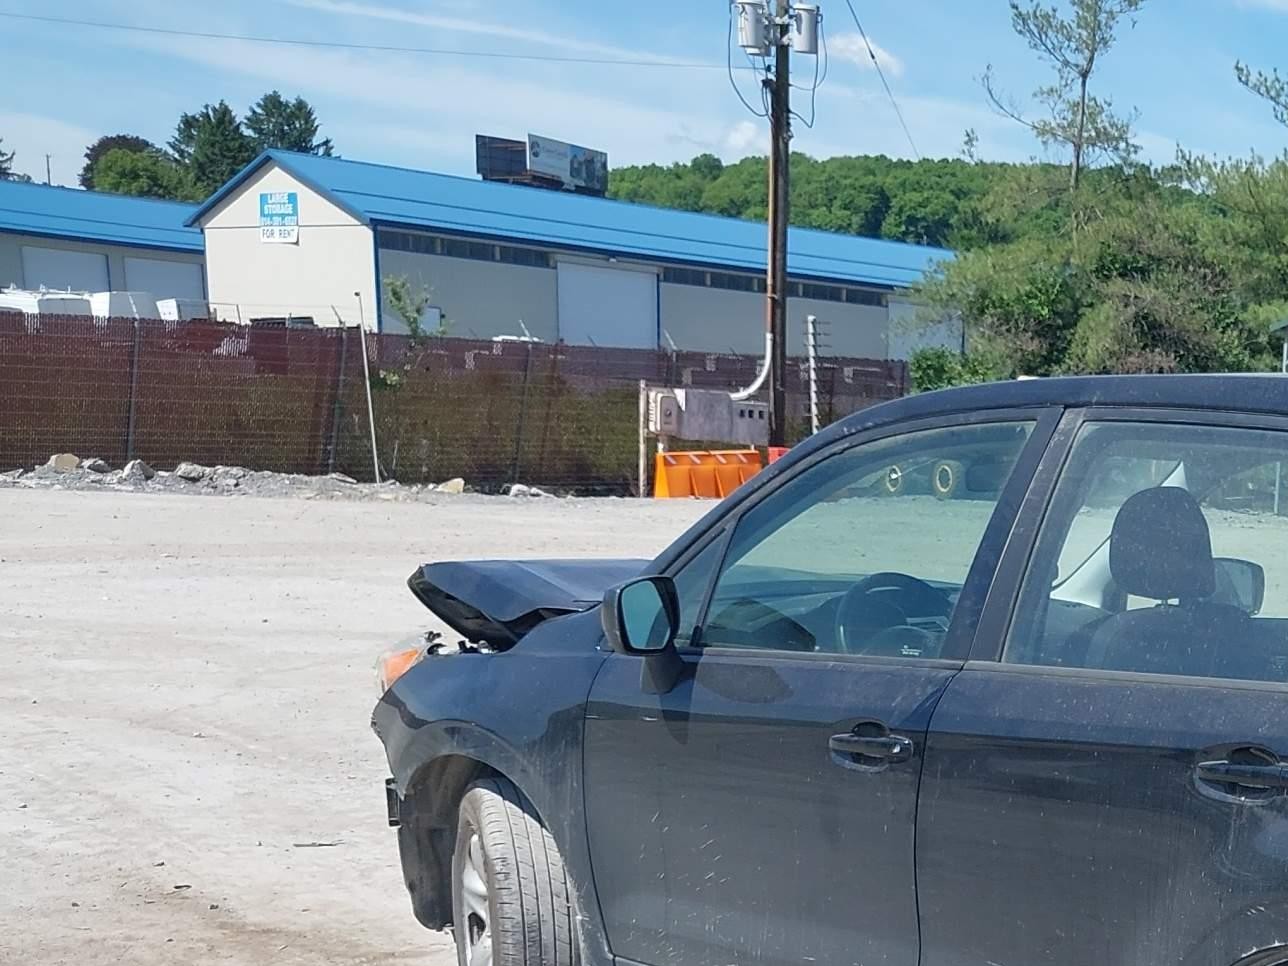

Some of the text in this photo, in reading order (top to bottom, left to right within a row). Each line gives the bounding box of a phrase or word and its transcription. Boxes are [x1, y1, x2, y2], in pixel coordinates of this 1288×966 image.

[264, 204, 294, 214] STORAGE
[262, 229, 295, 238] FOR RENT
